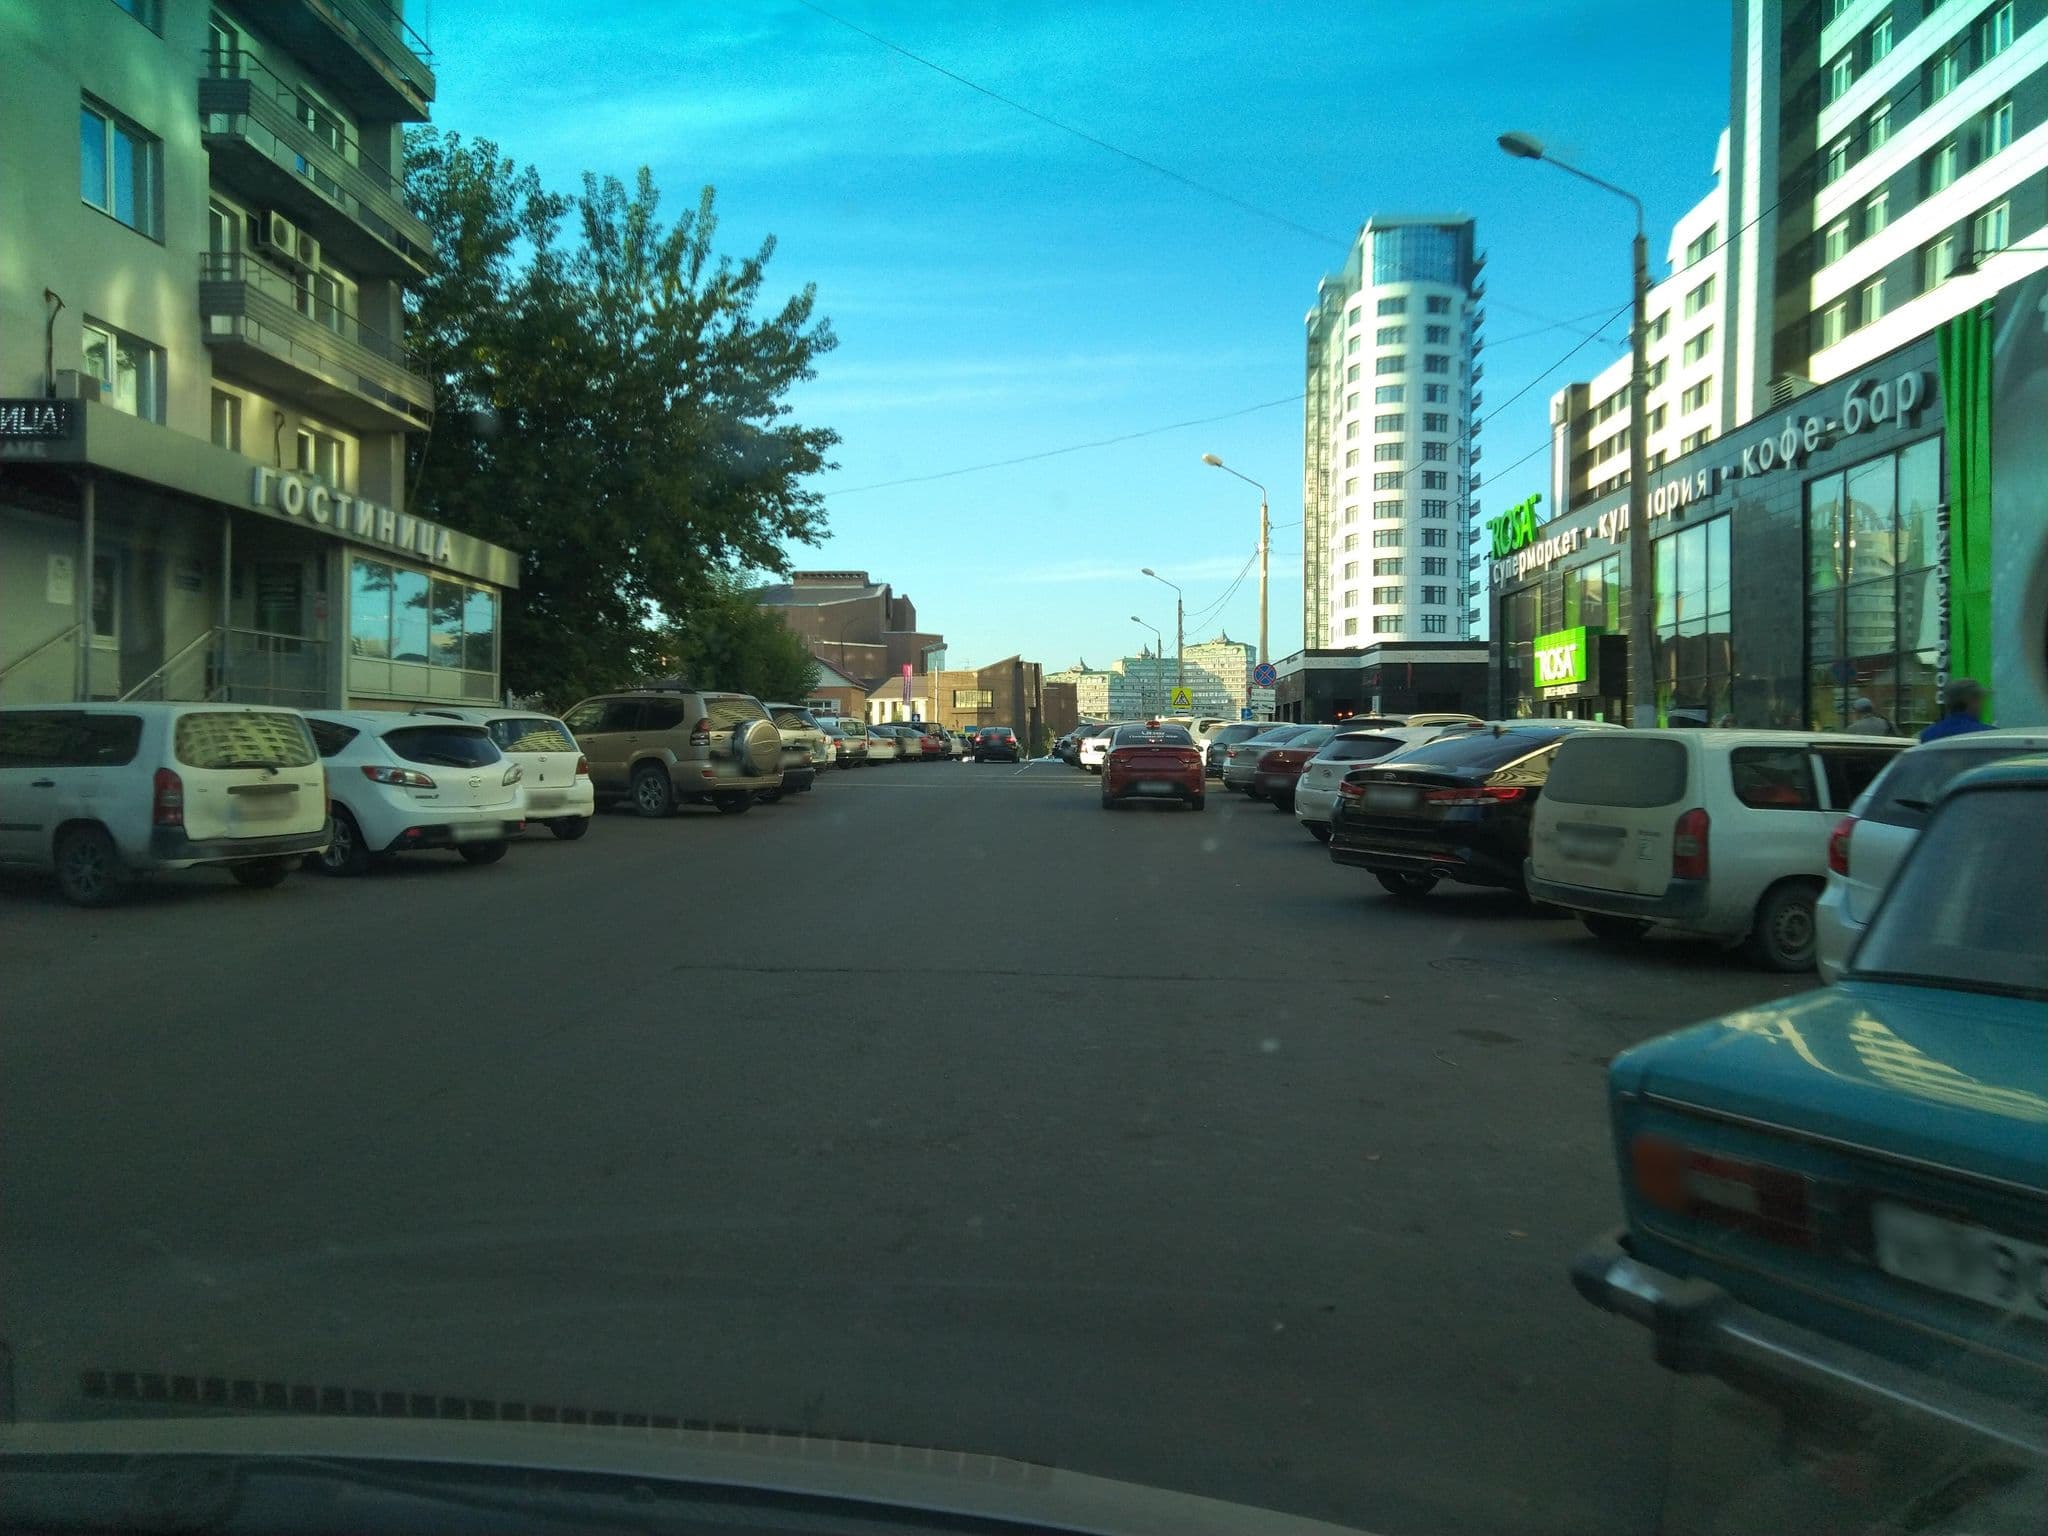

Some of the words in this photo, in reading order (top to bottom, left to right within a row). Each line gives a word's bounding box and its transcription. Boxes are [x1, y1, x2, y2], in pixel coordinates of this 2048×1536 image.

[254, 465, 451, 563] ГОСТИНИЦА
[1493, 527, 1579, 589] супермаркет
[1598, 467, 1708, 545] кулария
[1742, 370, 1921, 478] кофе-бар
